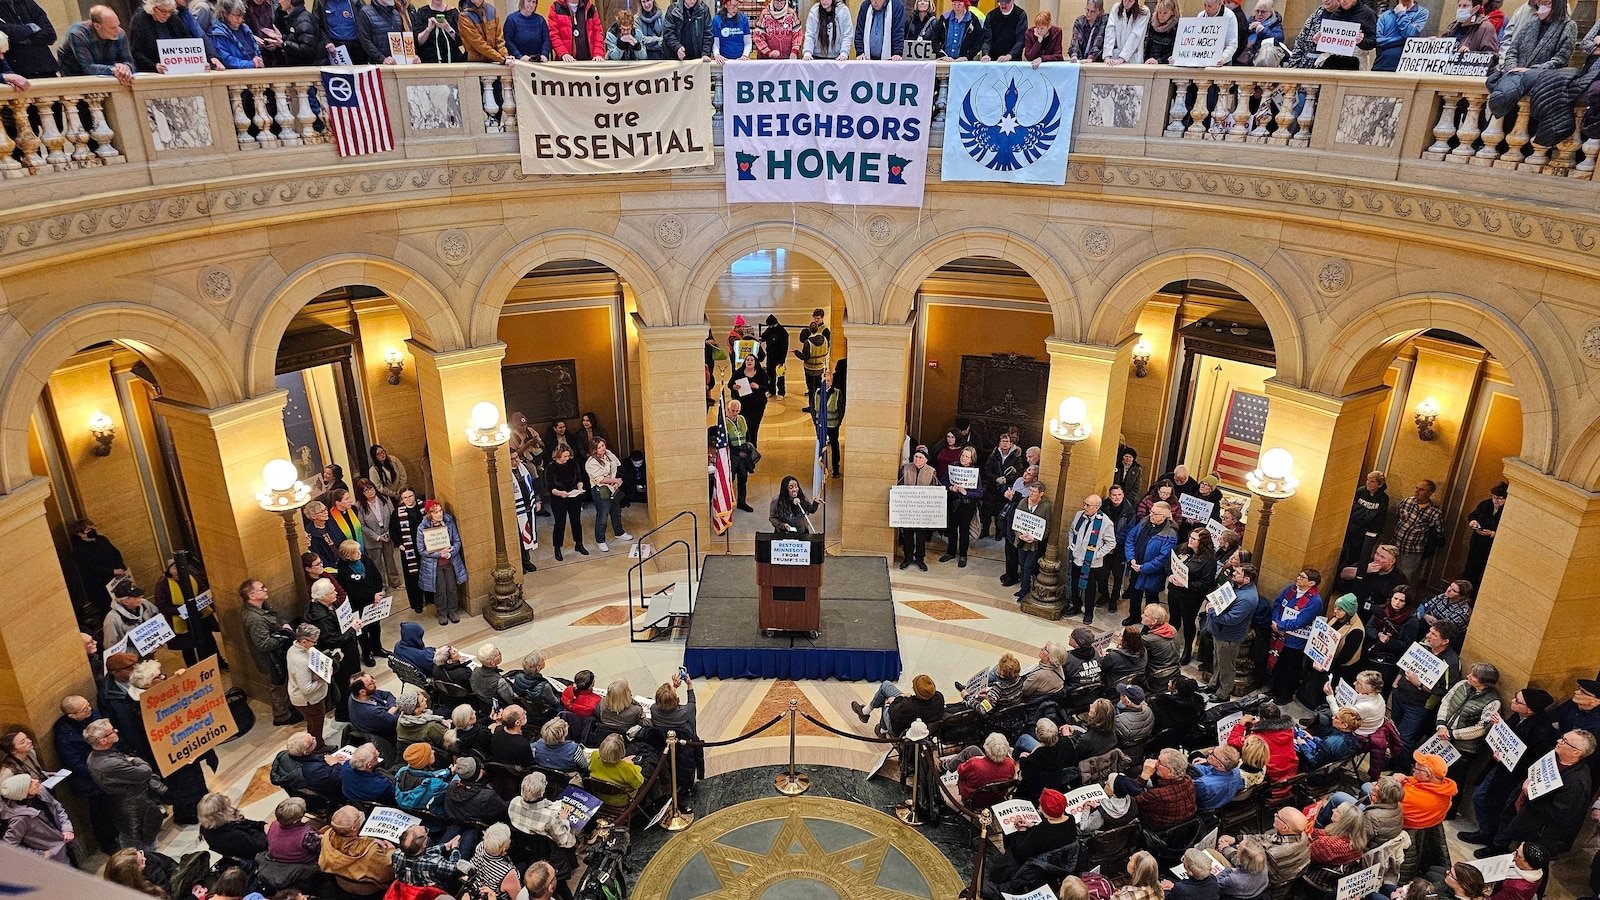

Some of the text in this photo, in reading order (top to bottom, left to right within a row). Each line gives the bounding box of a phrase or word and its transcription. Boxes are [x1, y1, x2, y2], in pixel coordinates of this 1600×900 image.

[1321, 36, 1336, 44] GOP
[1341, 29, 1357, 37] DIED
[162, 46, 202, 55] MN'S DIED
[907, 41, 931, 59] ICE
[1405, 39, 1452, 54] STRONGER
[164, 57, 182, 65] GOP
[1398, 57, 1447, 73] TOGETHER
[530, 71, 695, 104] immigrants
[736, 80, 919, 107] BRING OUR
[594, 111, 640, 128] are
[733, 113, 921, 142] NEIGHBORS
[535, 128, 704, 160] ESSENTIAL
[767, 149, 882, 183] HOME
[1082, 660, 1099, 671] BAD
[1409, 650, 1440, 675] MINNESOTA
[1416, 648, 1441, 667] RESTORE
[1400, 660, 1433, 686] TRUMP'S ICE
[1411, 660, 1428, 674] FROM
[146, 669, 215, 709] Speak Up for
[155, 683, 214, 722] Immigrants
[150, 693, 225, 742] Speak Against
[170, 712, 215, 746] Immoral
[1500, 723, 1519, 747] RESTORE
[167, 724, 228, 764] Legislation
[1494, 725, 1519, 757] MINNESOTA
[1496, 737, 1509, 753] FROM
[1086, 790, 1103, 800] DIED
[380, 810, 411, 823] RESTORE
[998, 805, 1035, 817] MN'S DIED
[371, 815, 408, 828] MINNESOT
[377, 822, 399, 832] FROM
[365, 826, 396, 839] TRUMP'S
